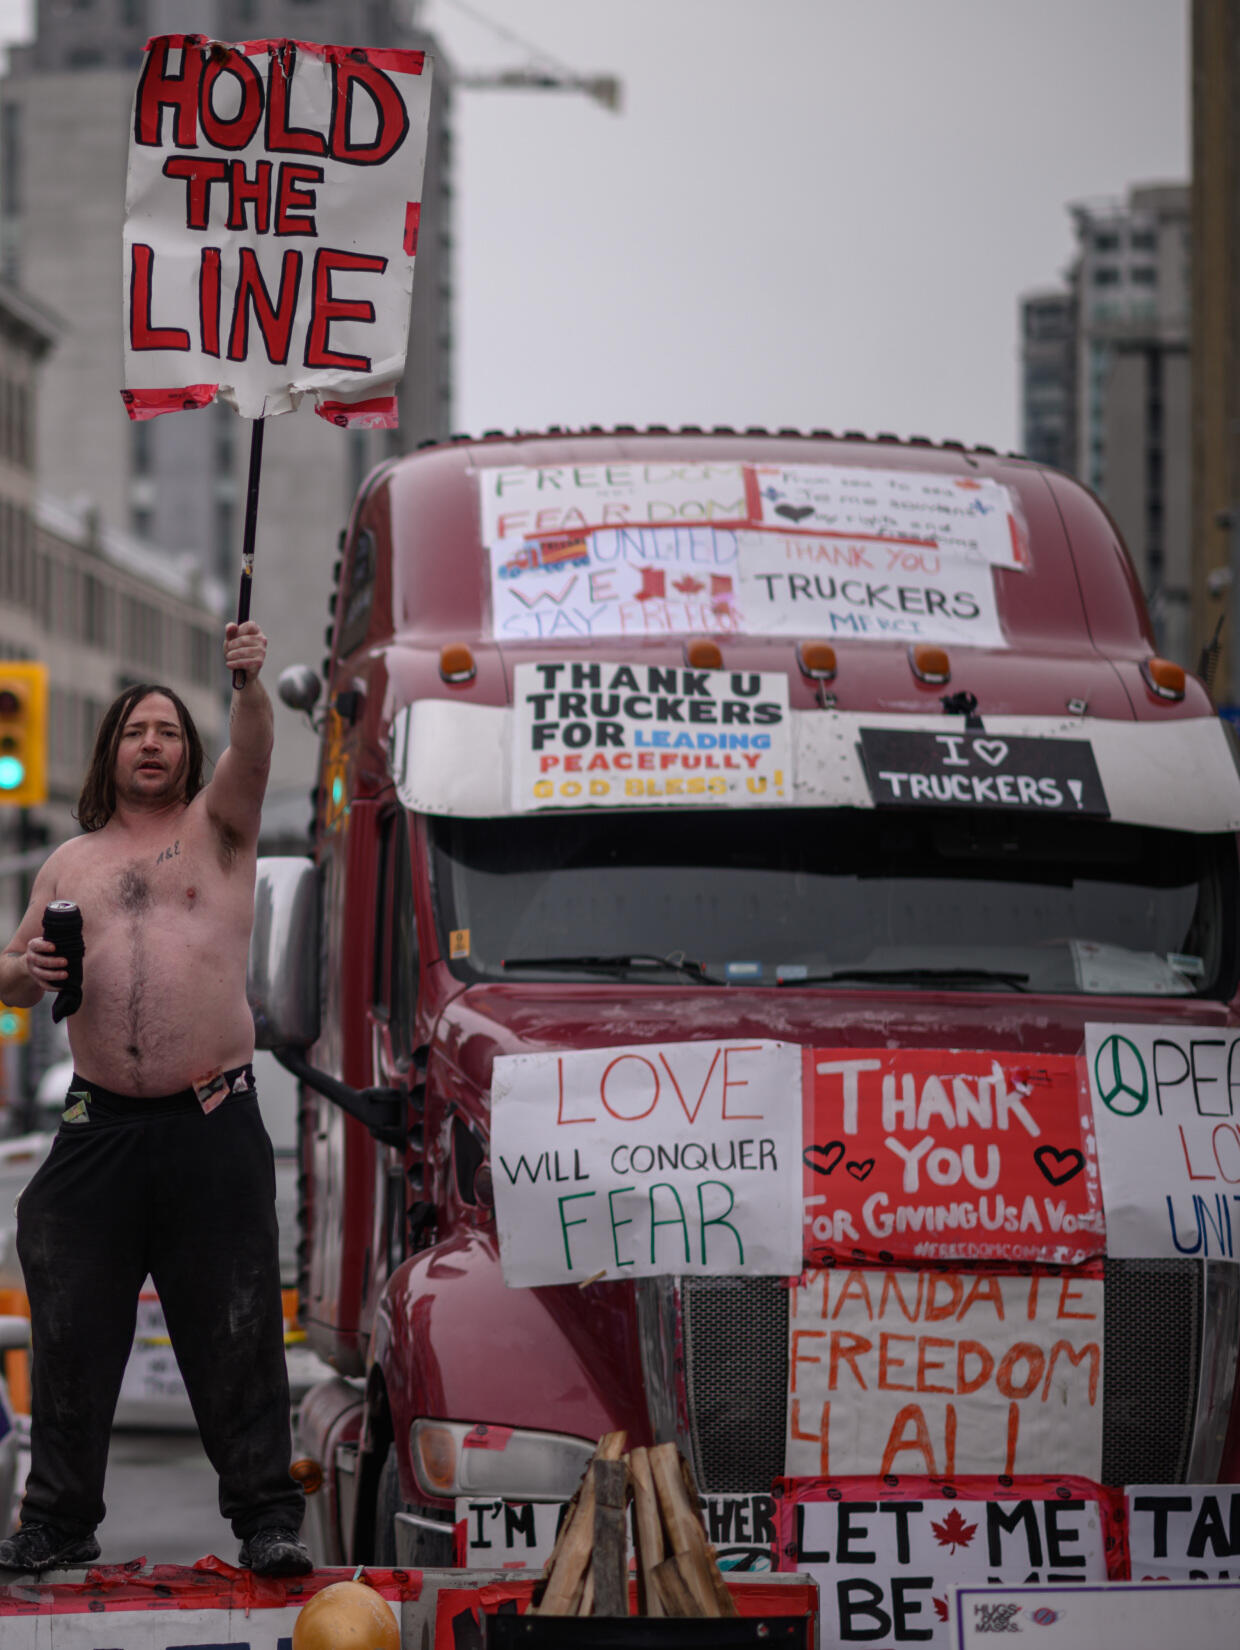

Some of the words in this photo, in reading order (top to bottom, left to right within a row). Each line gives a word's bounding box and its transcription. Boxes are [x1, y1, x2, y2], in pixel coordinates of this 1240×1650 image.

[134, 36, 410, 166] HOLD
[162, 154, 326, 238] THE
[130, 243, 388, 372] LINE
[593, 527, 739, 565] UNITED
[777, 537, 875, 570] THANK
[883, 547, 941, 575] YOU
[508, 568, 620, 609] WE
[754, 572, 981, 620] TRUCKERS
[535, 663, 712, 698] THANK
[730, 672, 761, 698] U
[526, 692, 783, 726] TRUCKERS
[531, 721, 626, 751] FOR
[633, 729, 772, 750] LEADING
[935, 735, 970, 766] I
[532, 779, 611, 799] GOD
[624, 776, 728, 798] BLESS
[539, 751, 762, 774] PEACEFULLY
[556, 1045, 765, 1126] LOVE
[816, 1059, 1041, 1137] THANK
[499, 1145, 590, 1185] WILL
[610, 1138, 778, 1175] CONQUER
[884, 1135, 1002, 1194] YOU
[557, 1179, 746, 1270] FEAR
[791, 1269, 1098, 1324] MANDATE
[790, 1329, 1101, 1407] FREEDOM
[790, 1398, 832, 1477] 4
[468, 1501, 537, 1549] I'M
[792, 1500, 924, 1564] LET
[986, 1499, 1087, 1568] ME
[837, 1576, 934, 1641] BE
